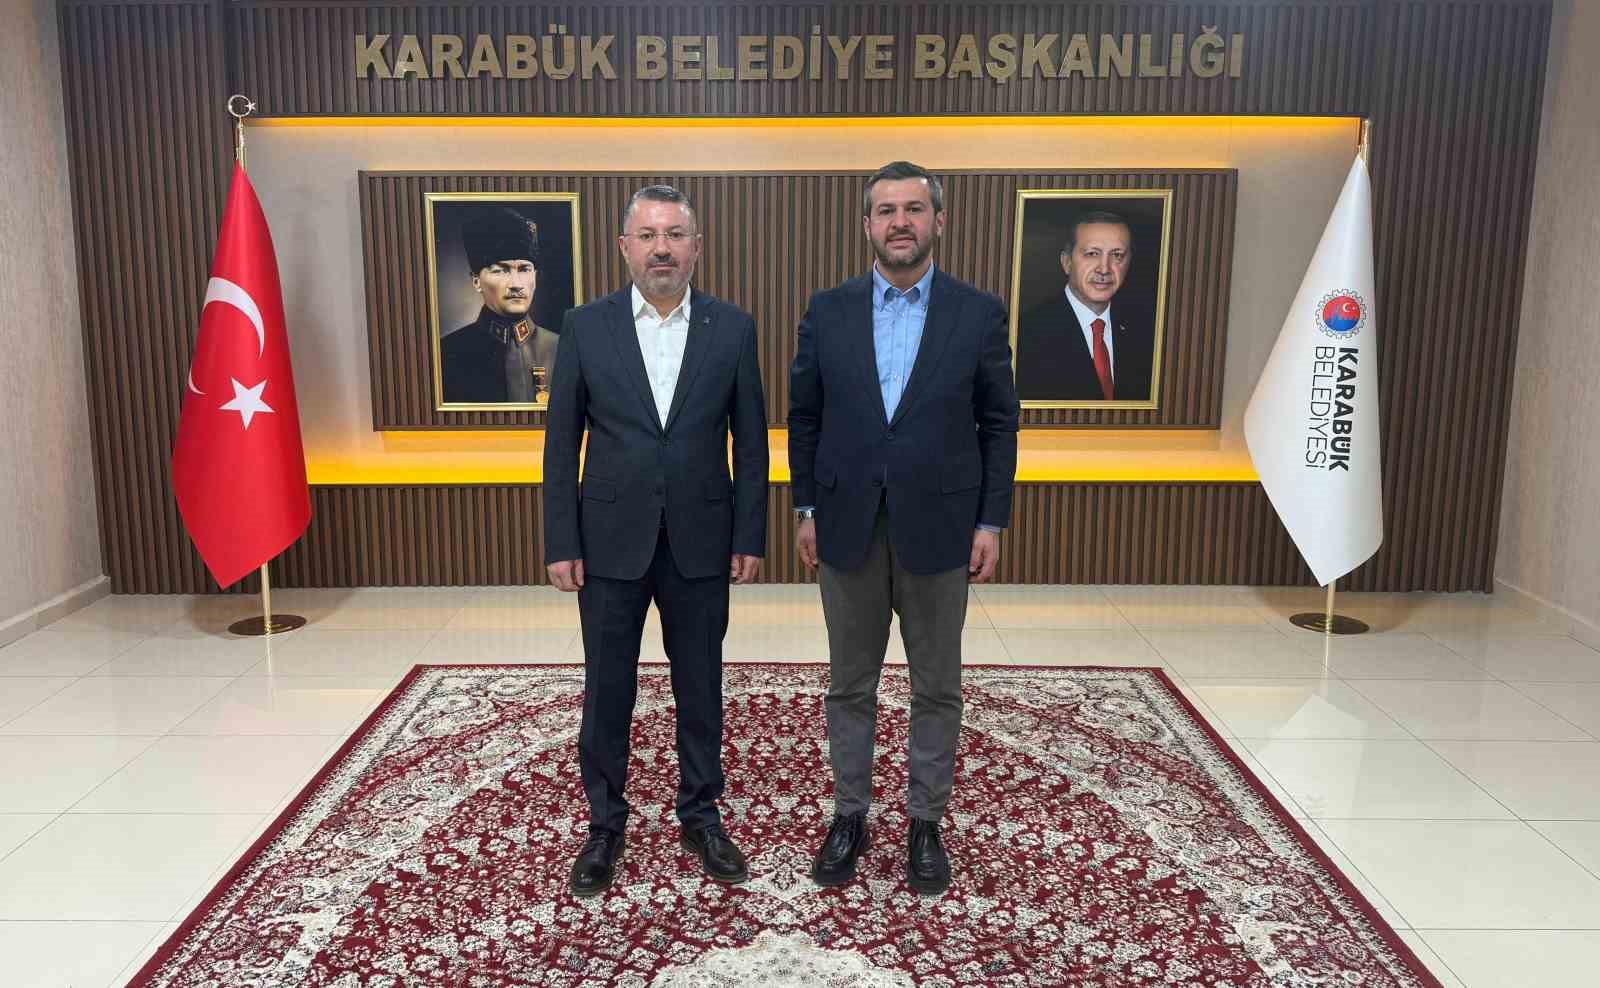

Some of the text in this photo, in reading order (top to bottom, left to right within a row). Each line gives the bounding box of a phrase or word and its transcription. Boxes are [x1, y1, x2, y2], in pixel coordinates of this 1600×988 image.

[355, 24, 1245, 84] KARABÜK BELEDİYE BAŞKANLIĞI
[1305, 346, 1336, 468] BELEDİYESİ
[1328, 347, 1360, 472] KARABÜK
